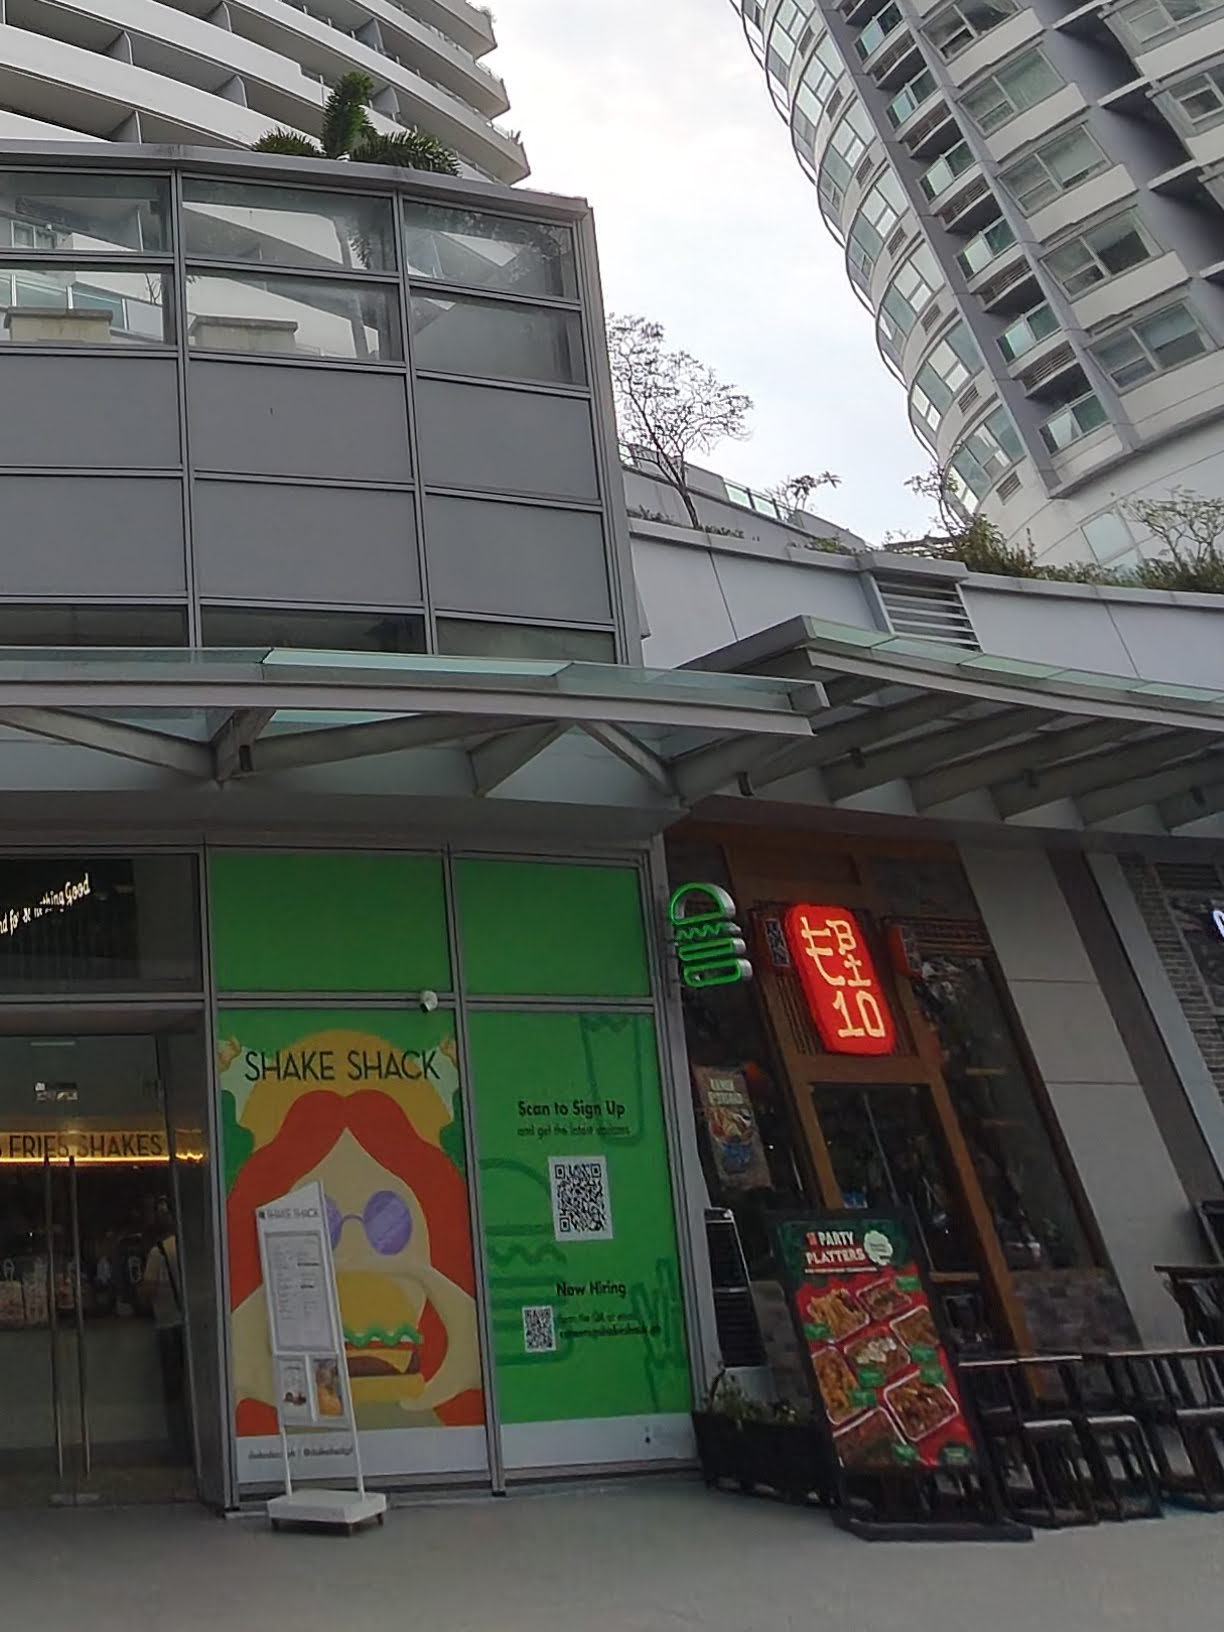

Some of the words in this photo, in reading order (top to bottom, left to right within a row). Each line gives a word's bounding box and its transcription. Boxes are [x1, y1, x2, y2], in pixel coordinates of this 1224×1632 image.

[64, 872, 91, 906] Good
[244, 1050, 336, 1082] SHAKE
[347, 1050, 441, 1081] SHACK
[517, 1099, 551, 1117] Scan
[554, 1101, 569, 1116] to
[572, 1098, 603, 1120] Sign
[605, 1100, 626, 1119] Up
[9, 1134, 70, 1158] FRIES
[77, 1133, 163, 1157] SHAKES
[817, 1230, 855, 1246] PARTY
[804, 1247, 867, 1265] PLATTERS
[556, 1281, 586, 1296] Now
[589, 1279, 627, 1299] Hiring
